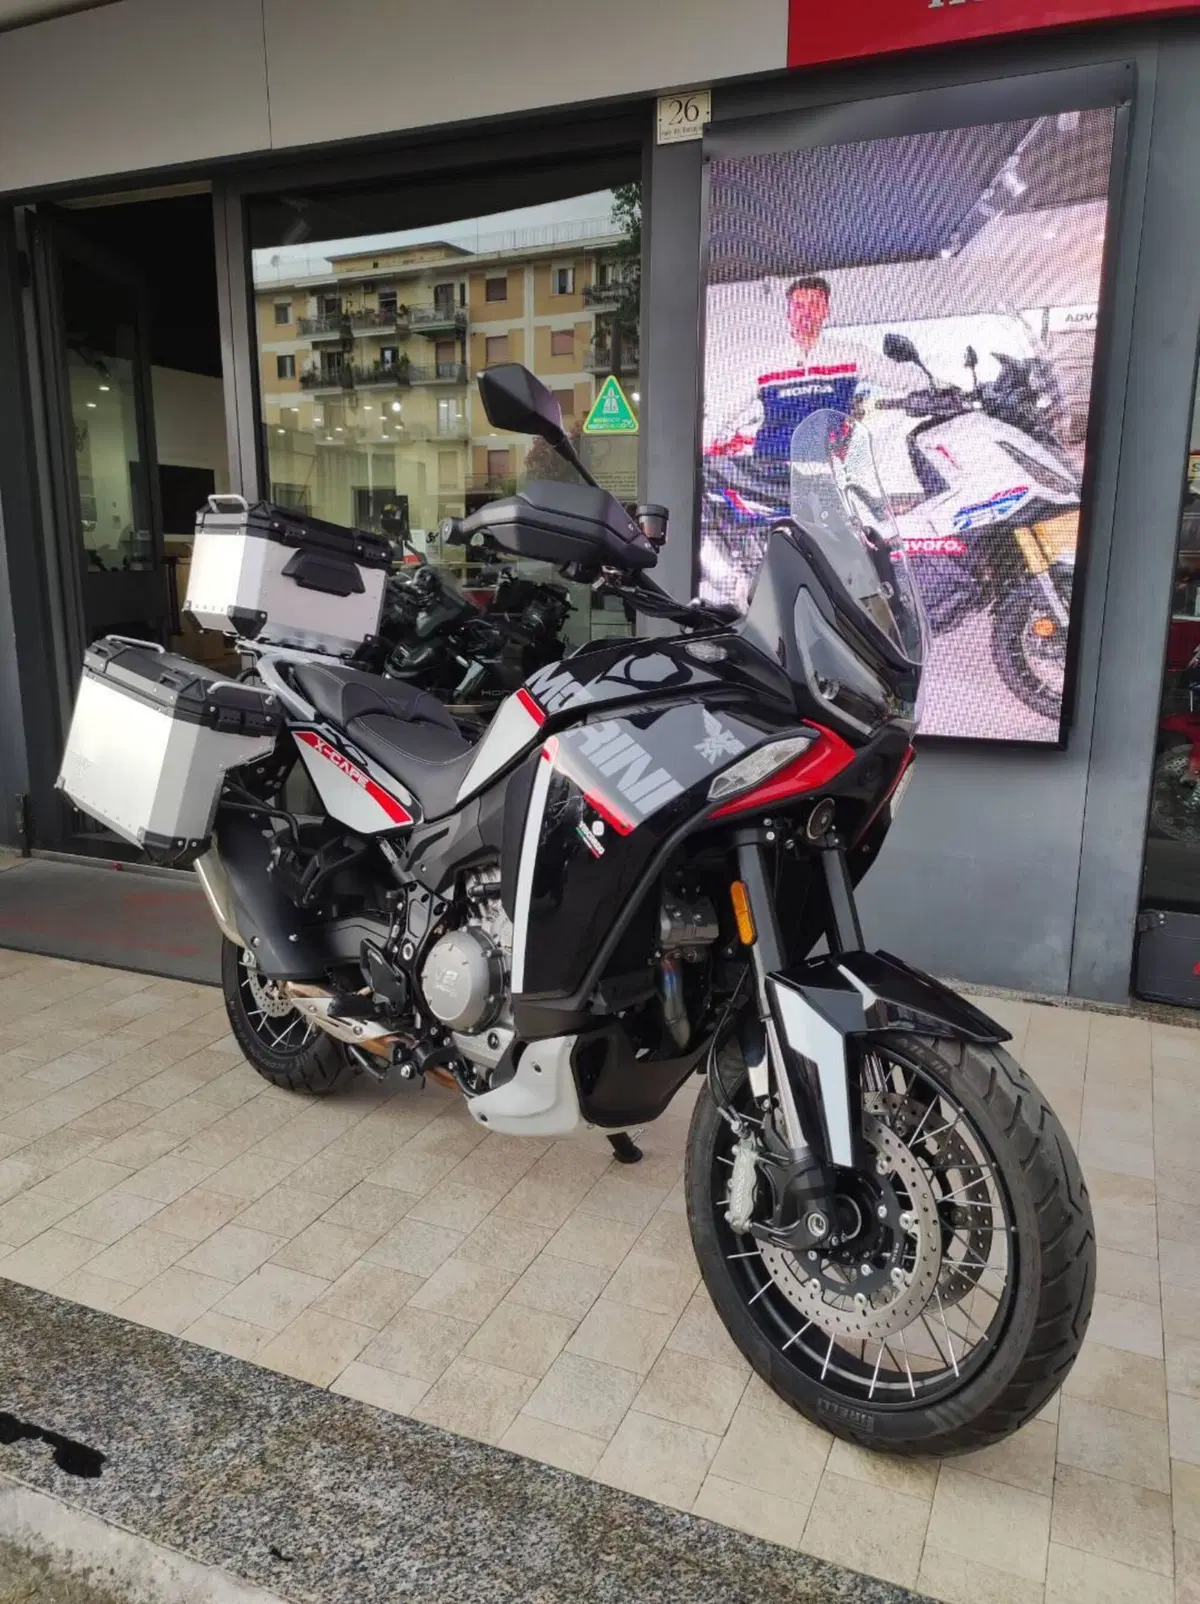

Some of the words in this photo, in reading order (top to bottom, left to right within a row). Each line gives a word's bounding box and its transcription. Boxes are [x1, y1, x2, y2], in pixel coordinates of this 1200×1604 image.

[669, 96, 699, 126] 26
[1065, 312, 1098, 322] ADV
[314, 738, 370, 789] X-CAPE
